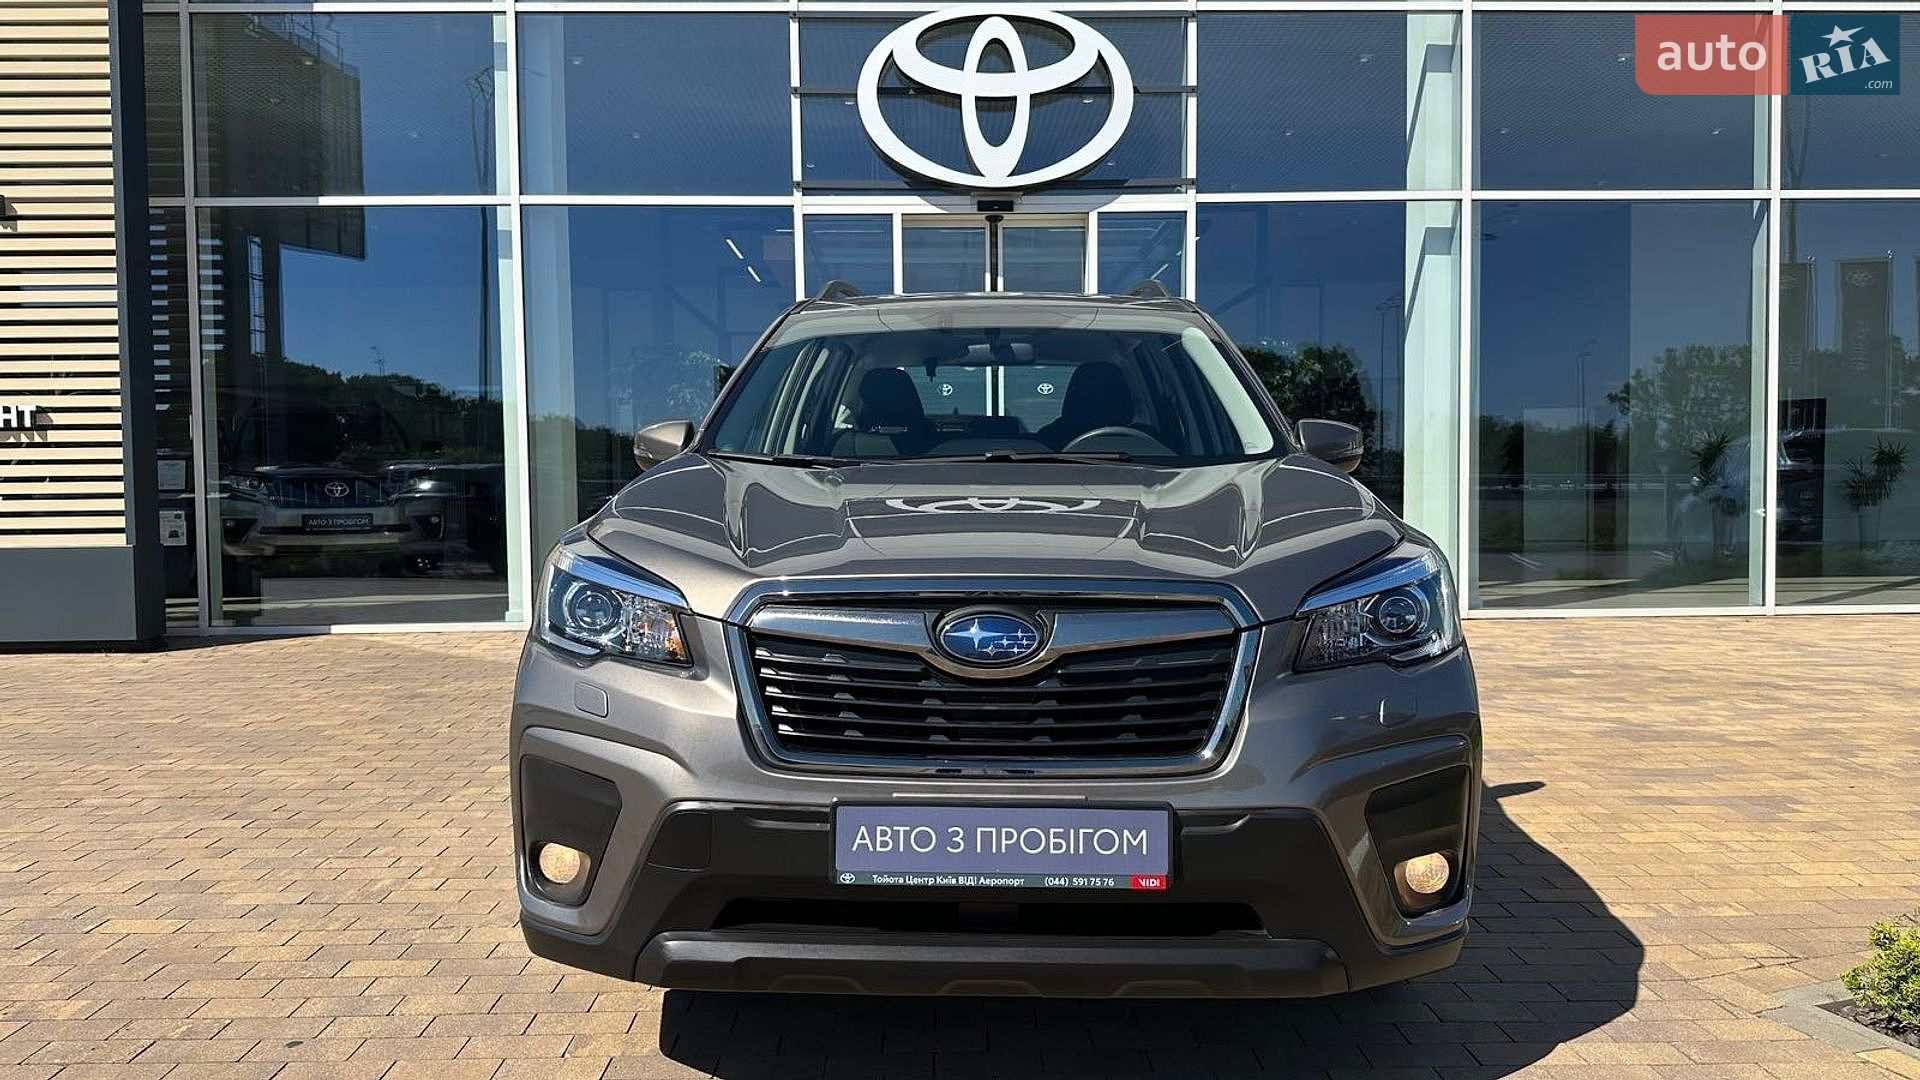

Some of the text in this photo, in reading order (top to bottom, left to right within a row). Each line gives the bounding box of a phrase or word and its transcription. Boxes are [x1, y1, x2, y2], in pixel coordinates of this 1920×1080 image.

[852, 825, 1148, 855] АВТО З ПРОБІГОМ
[872, 874, 904, 884] Тойота
[906, 876, 935, 886] Центр
[936, 876, 957, 885] Київ
[979, 877, 1025, 887] Аеропорт
[1044, 877, 1069, 887] (044)
[1072, 877, 1088, 886] 591
[1090, 877, 1101, 886] 75
[1102, 877, 1115, 886] 76
